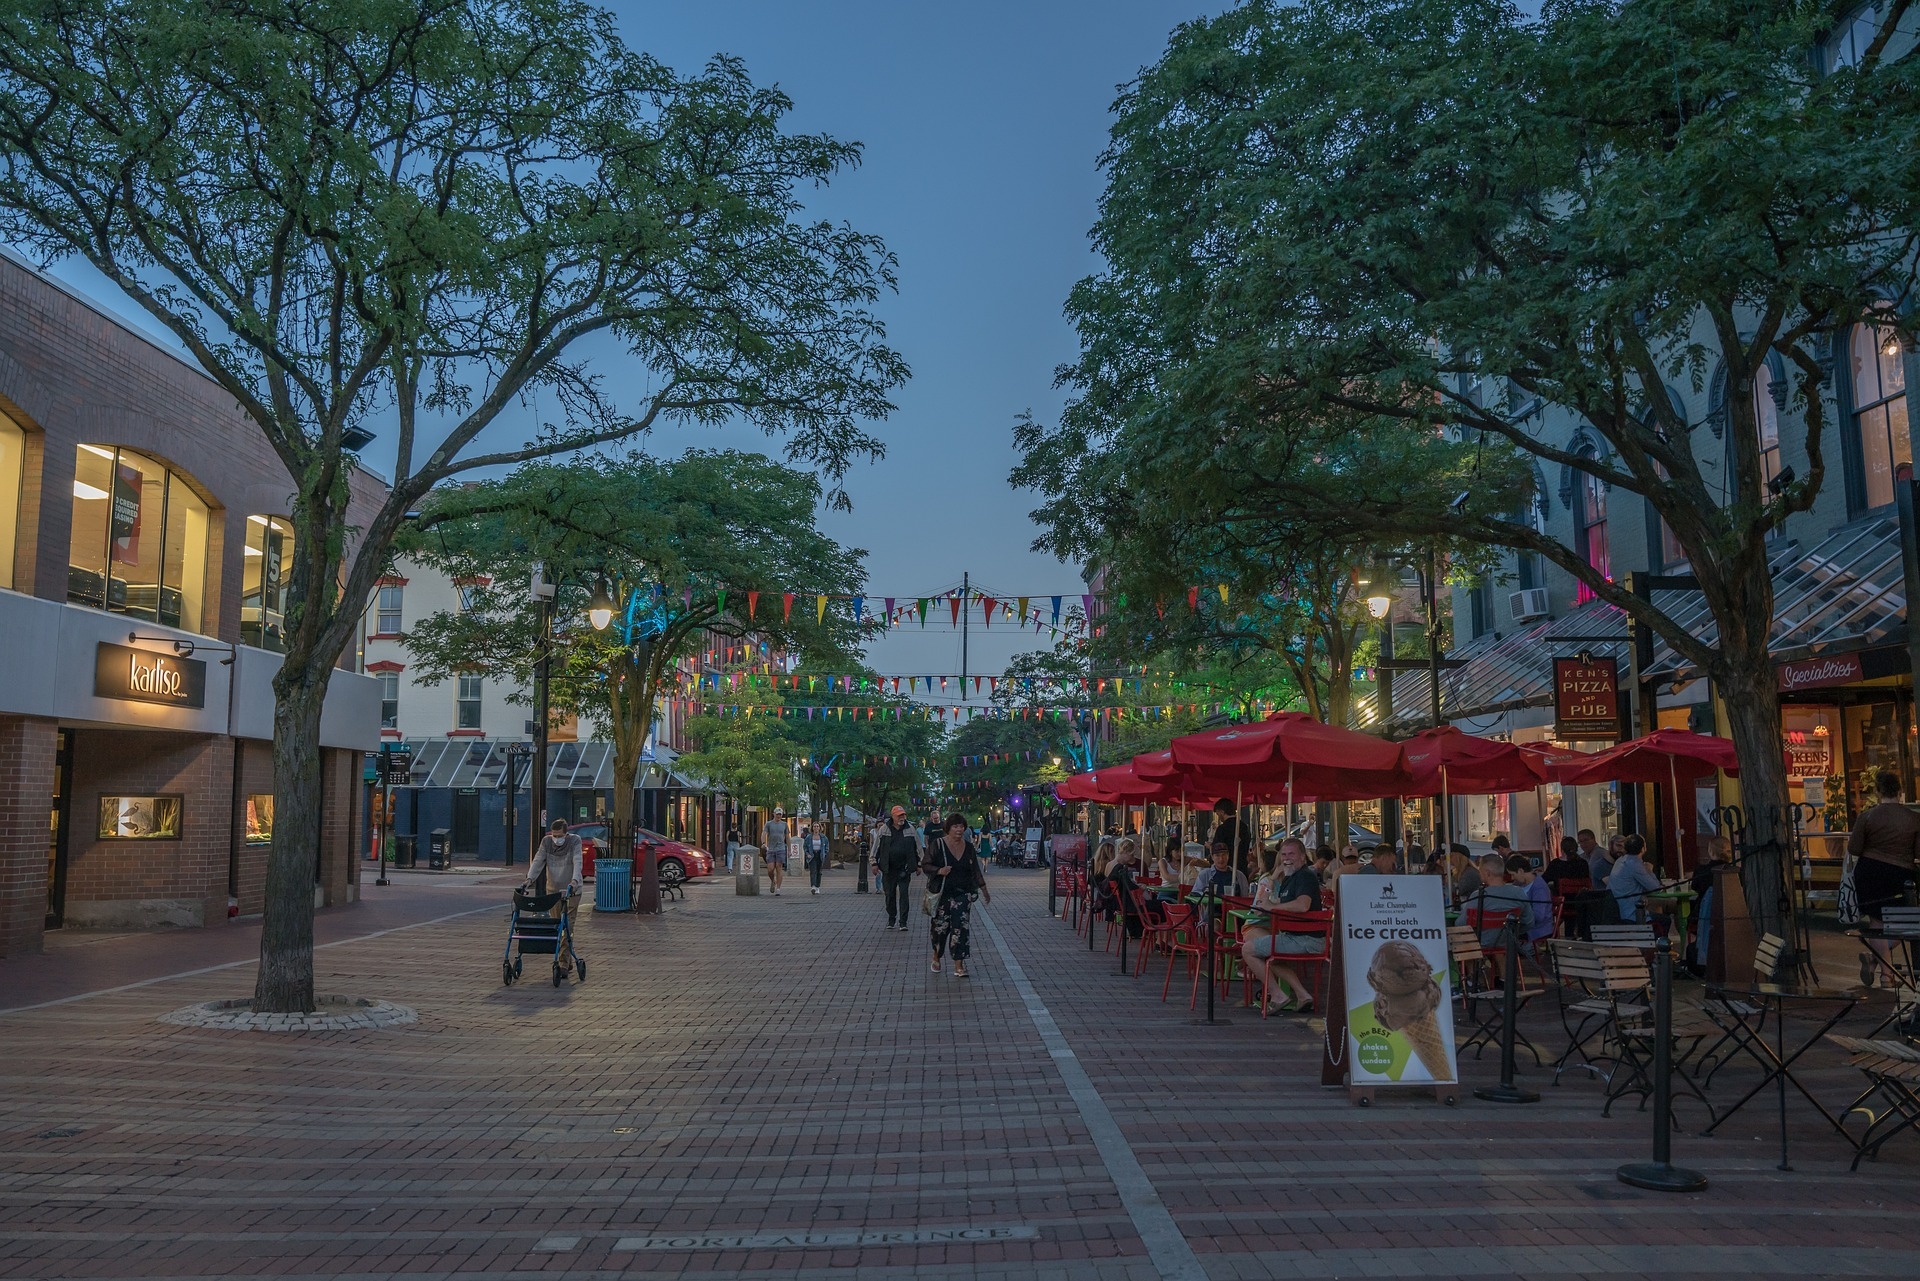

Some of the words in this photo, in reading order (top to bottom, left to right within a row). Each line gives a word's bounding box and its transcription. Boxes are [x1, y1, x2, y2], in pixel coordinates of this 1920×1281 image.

[119, 497, 139, 511] CREDIT
[130, 653, 181, 696] karlise
[1564, 668, 1609, 678] KEN'S
[1783, 660, 1857, 689] Specialties
[1562, 681, 1612, 693] PIZZA
[1581, 695, 1596, 703] AND
[1570, 704, 1607, 716] PUB
[1792, 765, 1832, 777] PIZZA
[1370, 901, 1385, 909] Lake
[1386, 901, 1417, 910] Champlain
[1370, 917, 1393, 925] small
[1395, 917, 1419, 925] batch
[1348, 923, 1375, 939] ice
[1379, 928, 1442, 940] cream
[1359, 1030, 1370, 1039] the
[1371, 1027, 1391, 1038] BEST
[644, 1228, 1013, 1247] PORT-AU-PRINCE
